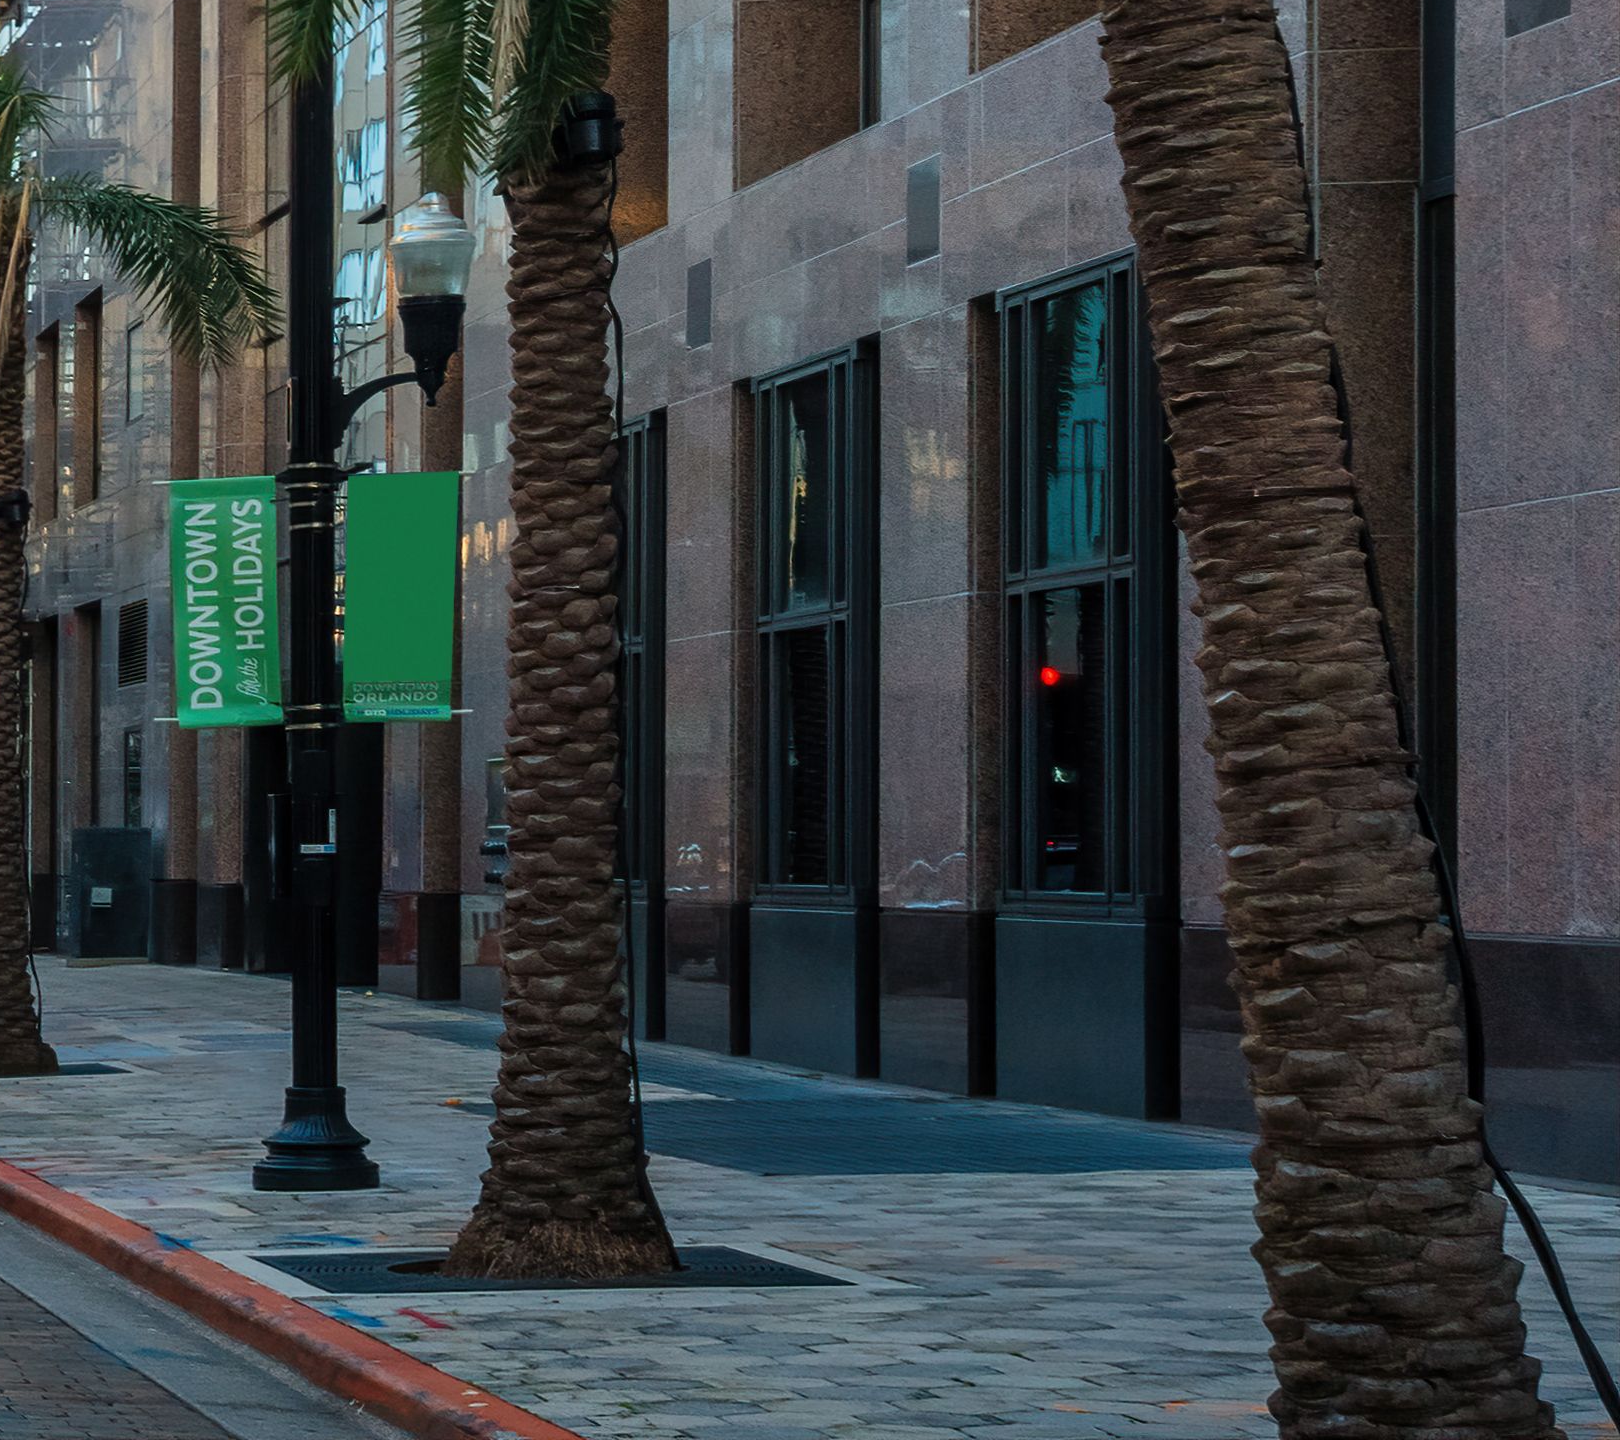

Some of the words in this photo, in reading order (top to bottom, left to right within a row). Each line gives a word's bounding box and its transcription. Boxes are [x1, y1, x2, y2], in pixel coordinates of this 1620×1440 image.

[183, 502, 225, 710] DOWNTOWN
[230, 498, 265, 650] HOLIDAYS
[353, 682, 439, 692] DOWNTOWN
[353, 691, 438, 703] ORLANDO
